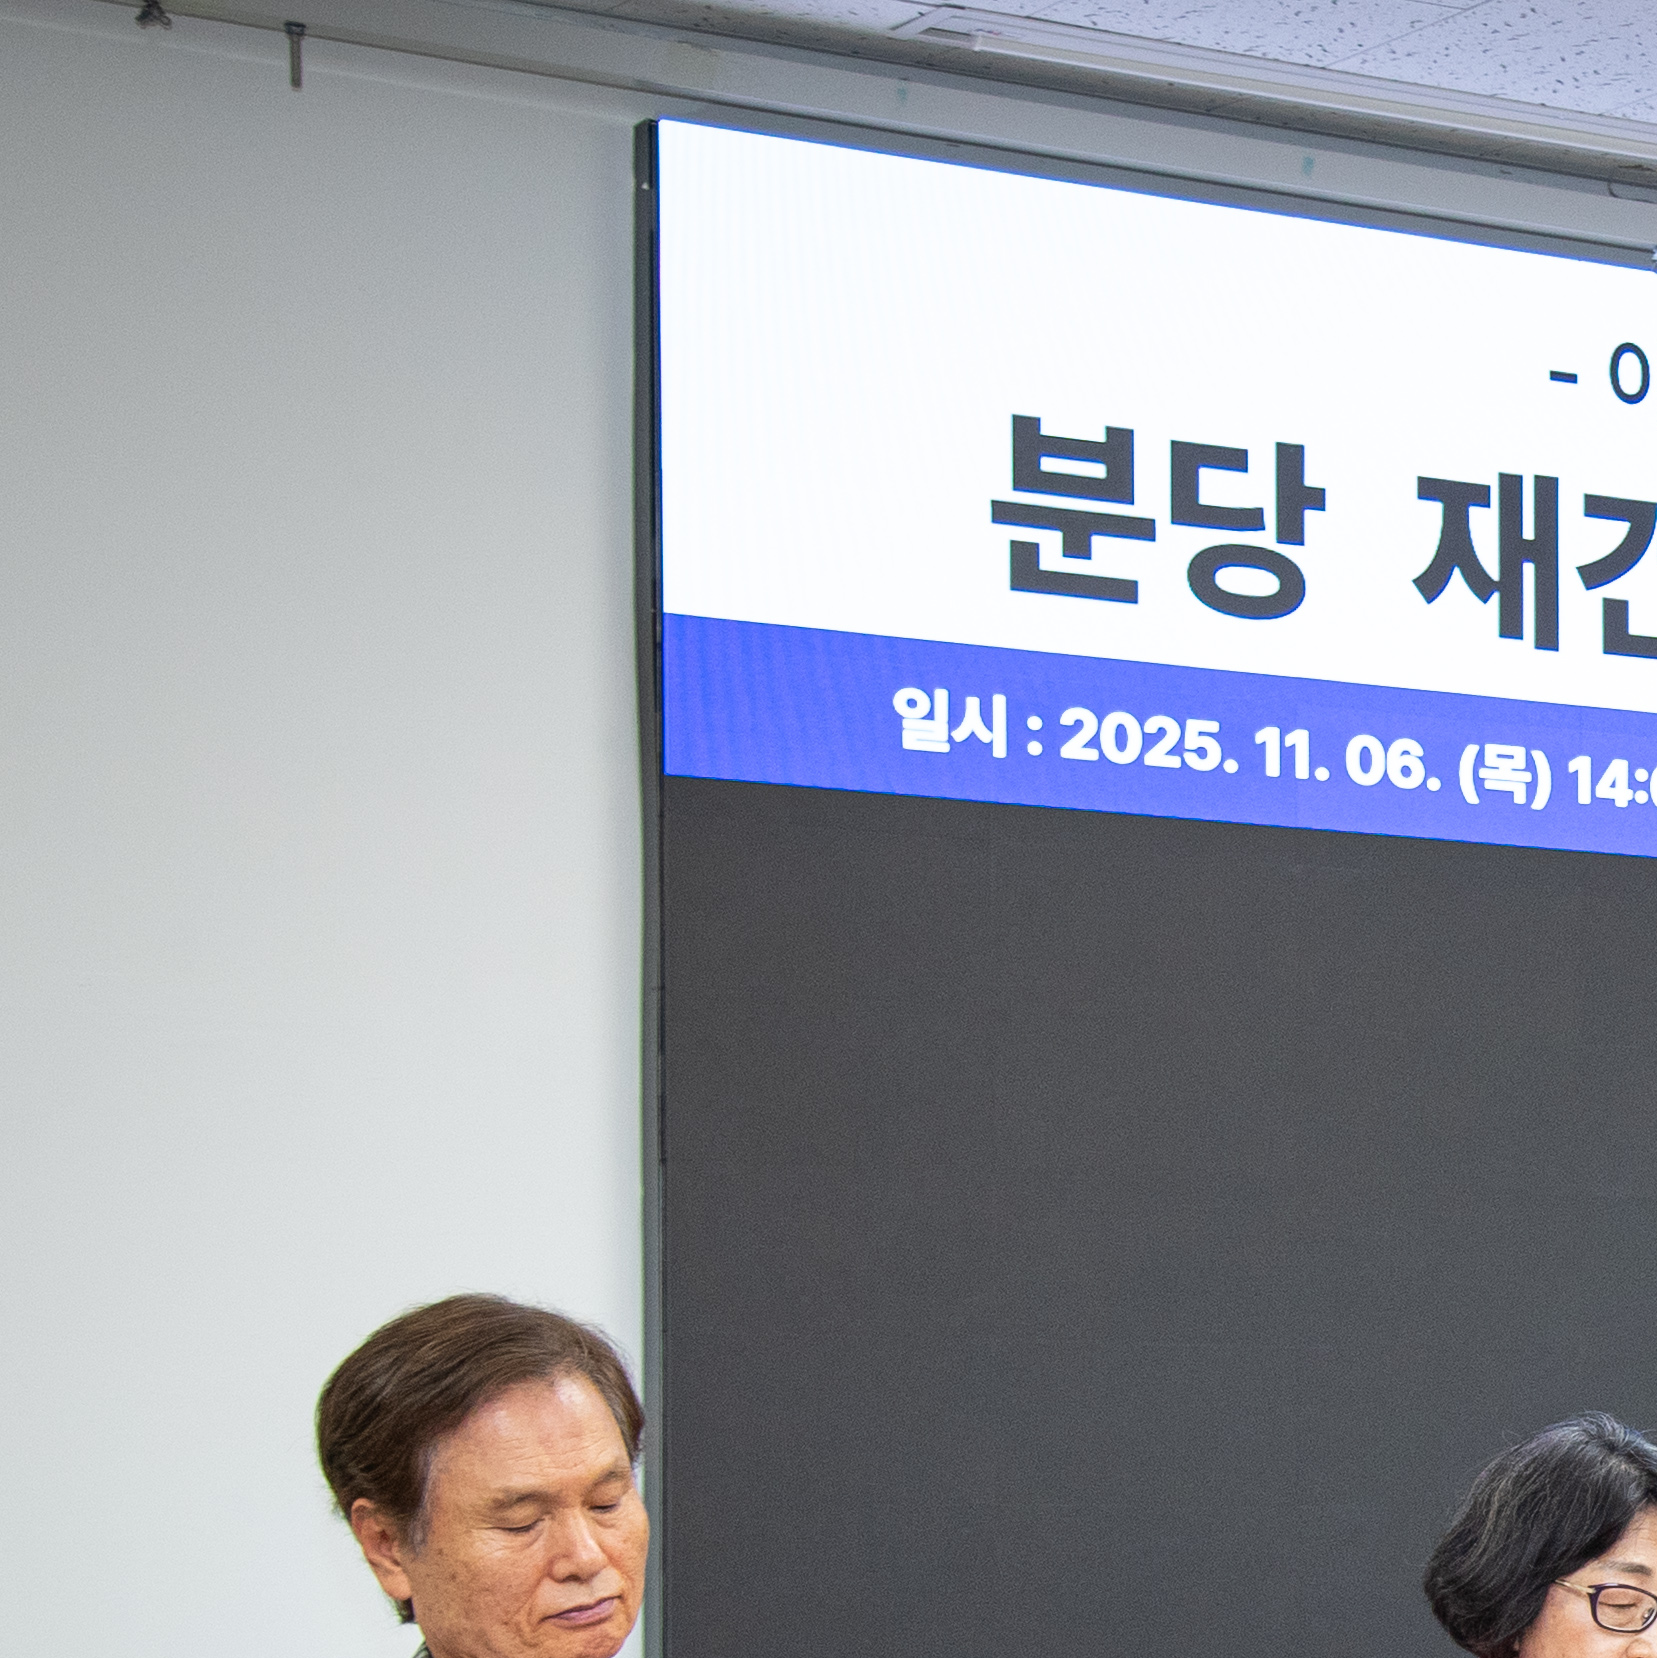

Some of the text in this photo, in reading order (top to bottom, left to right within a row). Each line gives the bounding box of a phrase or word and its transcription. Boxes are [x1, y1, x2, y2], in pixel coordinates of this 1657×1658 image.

[990, 413, 1327, 621] 분당
[892, 687, 1007, 759] 일시
[1059, 706, 1239, 774] 2025.
[1254, 726, 1330, 782] 11.
[1345, 733, 1442, 792] 06.
[1458, 743, 1552, 811] (목)
